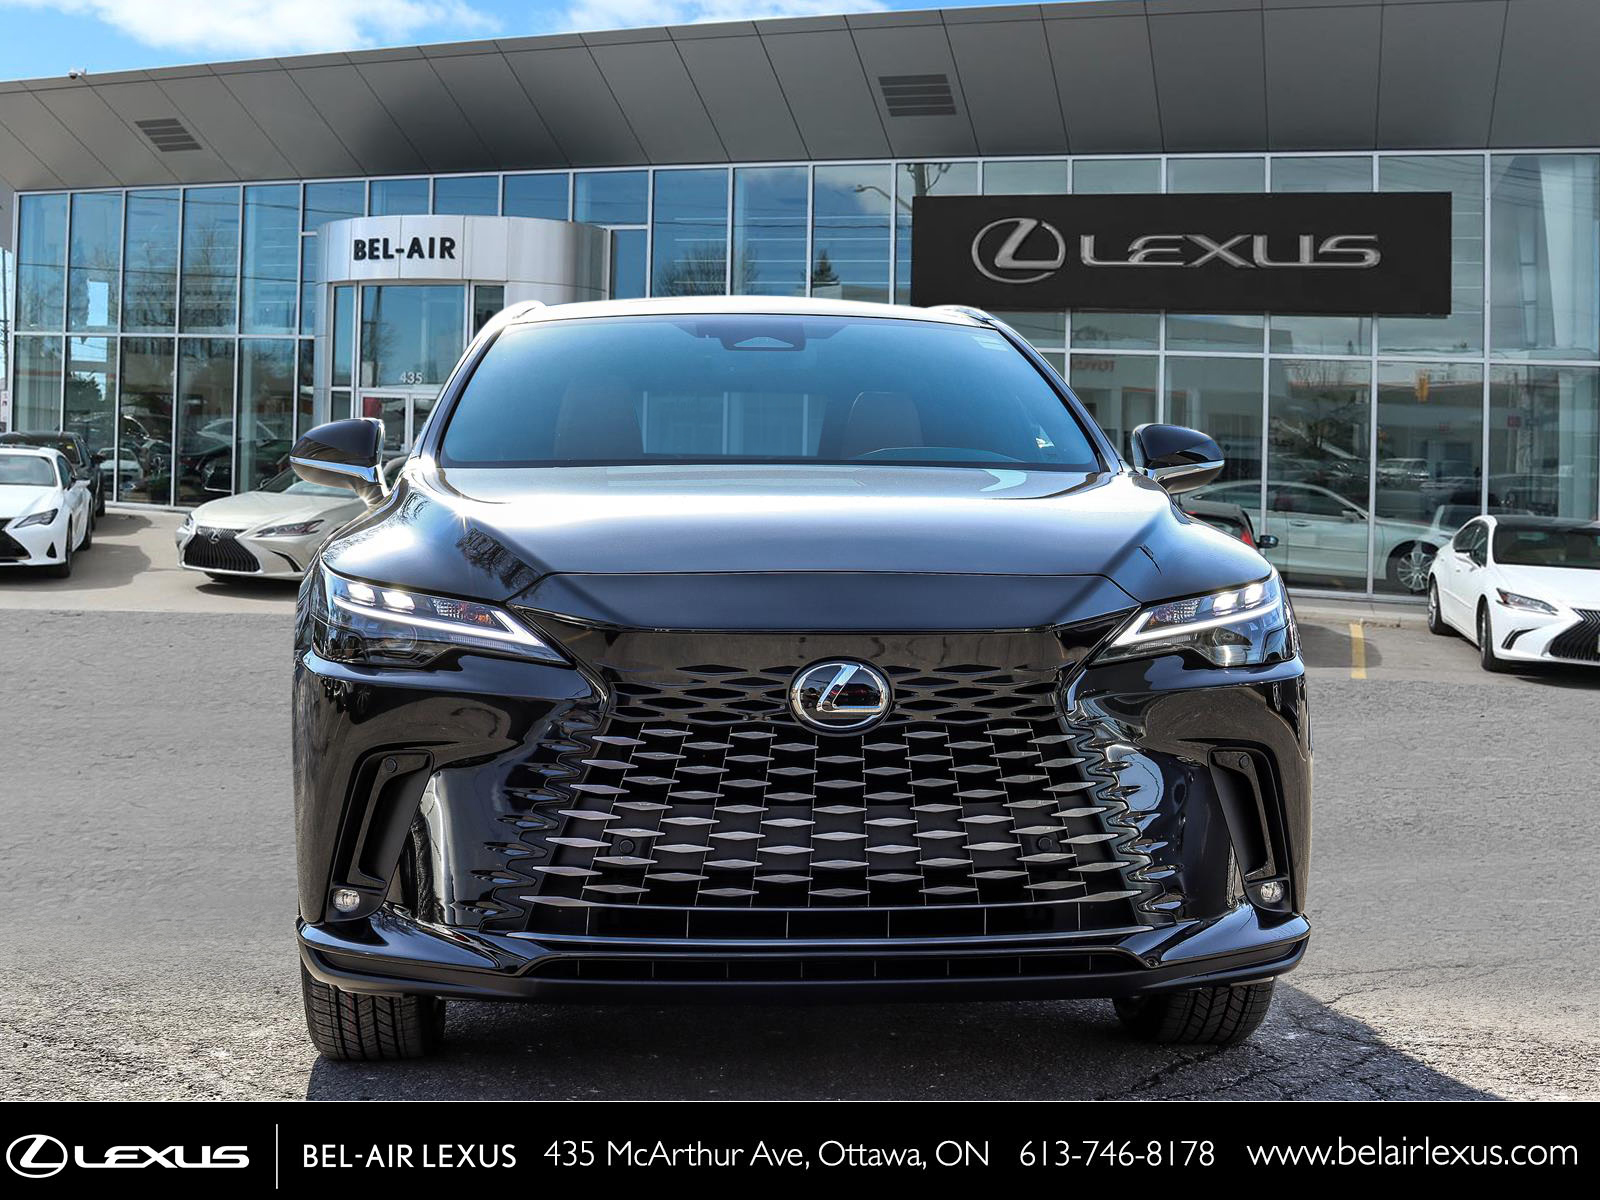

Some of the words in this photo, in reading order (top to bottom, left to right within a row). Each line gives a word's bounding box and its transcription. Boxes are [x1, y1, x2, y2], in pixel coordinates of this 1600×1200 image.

[354, 237, 457, 261] BEL-AIR
[1080, 234, 1381, 269] LEXUS
[401, 371, 423, 385] 435
